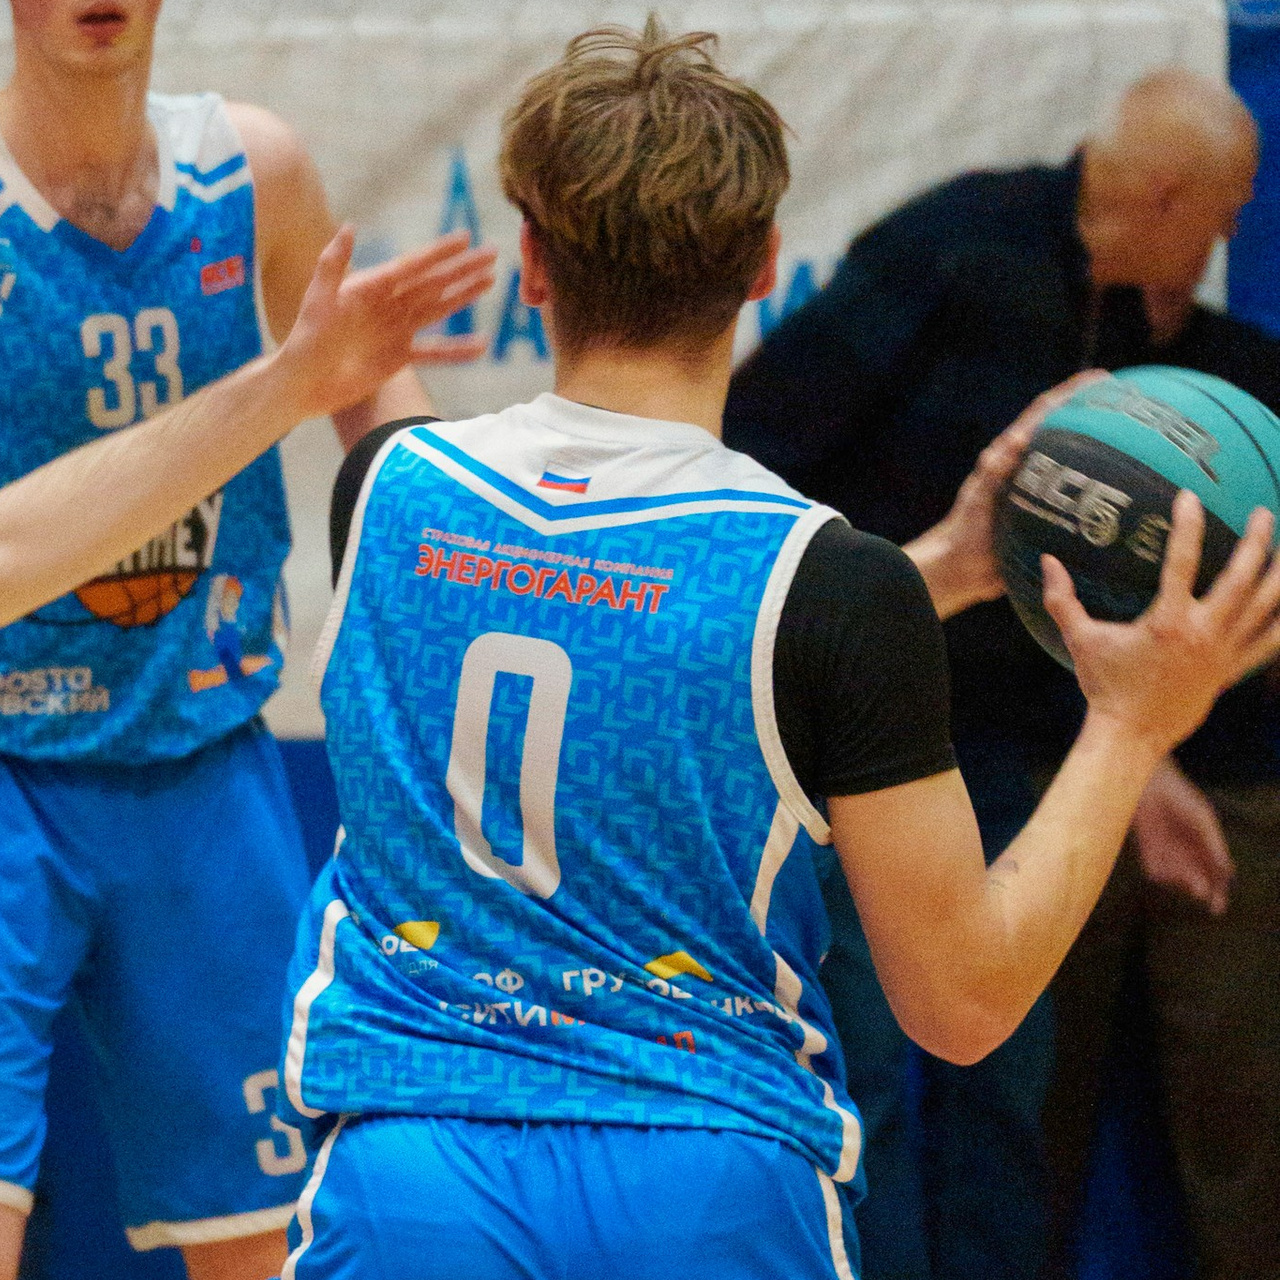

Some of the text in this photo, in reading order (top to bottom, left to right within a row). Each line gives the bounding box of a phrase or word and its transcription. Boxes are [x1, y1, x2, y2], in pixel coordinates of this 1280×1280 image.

[81, 307, 183, 428] 33
[415, 543, 669, 614] ЭНЕРГОГАРАНТ
[446, 631, 572, 899] 0
